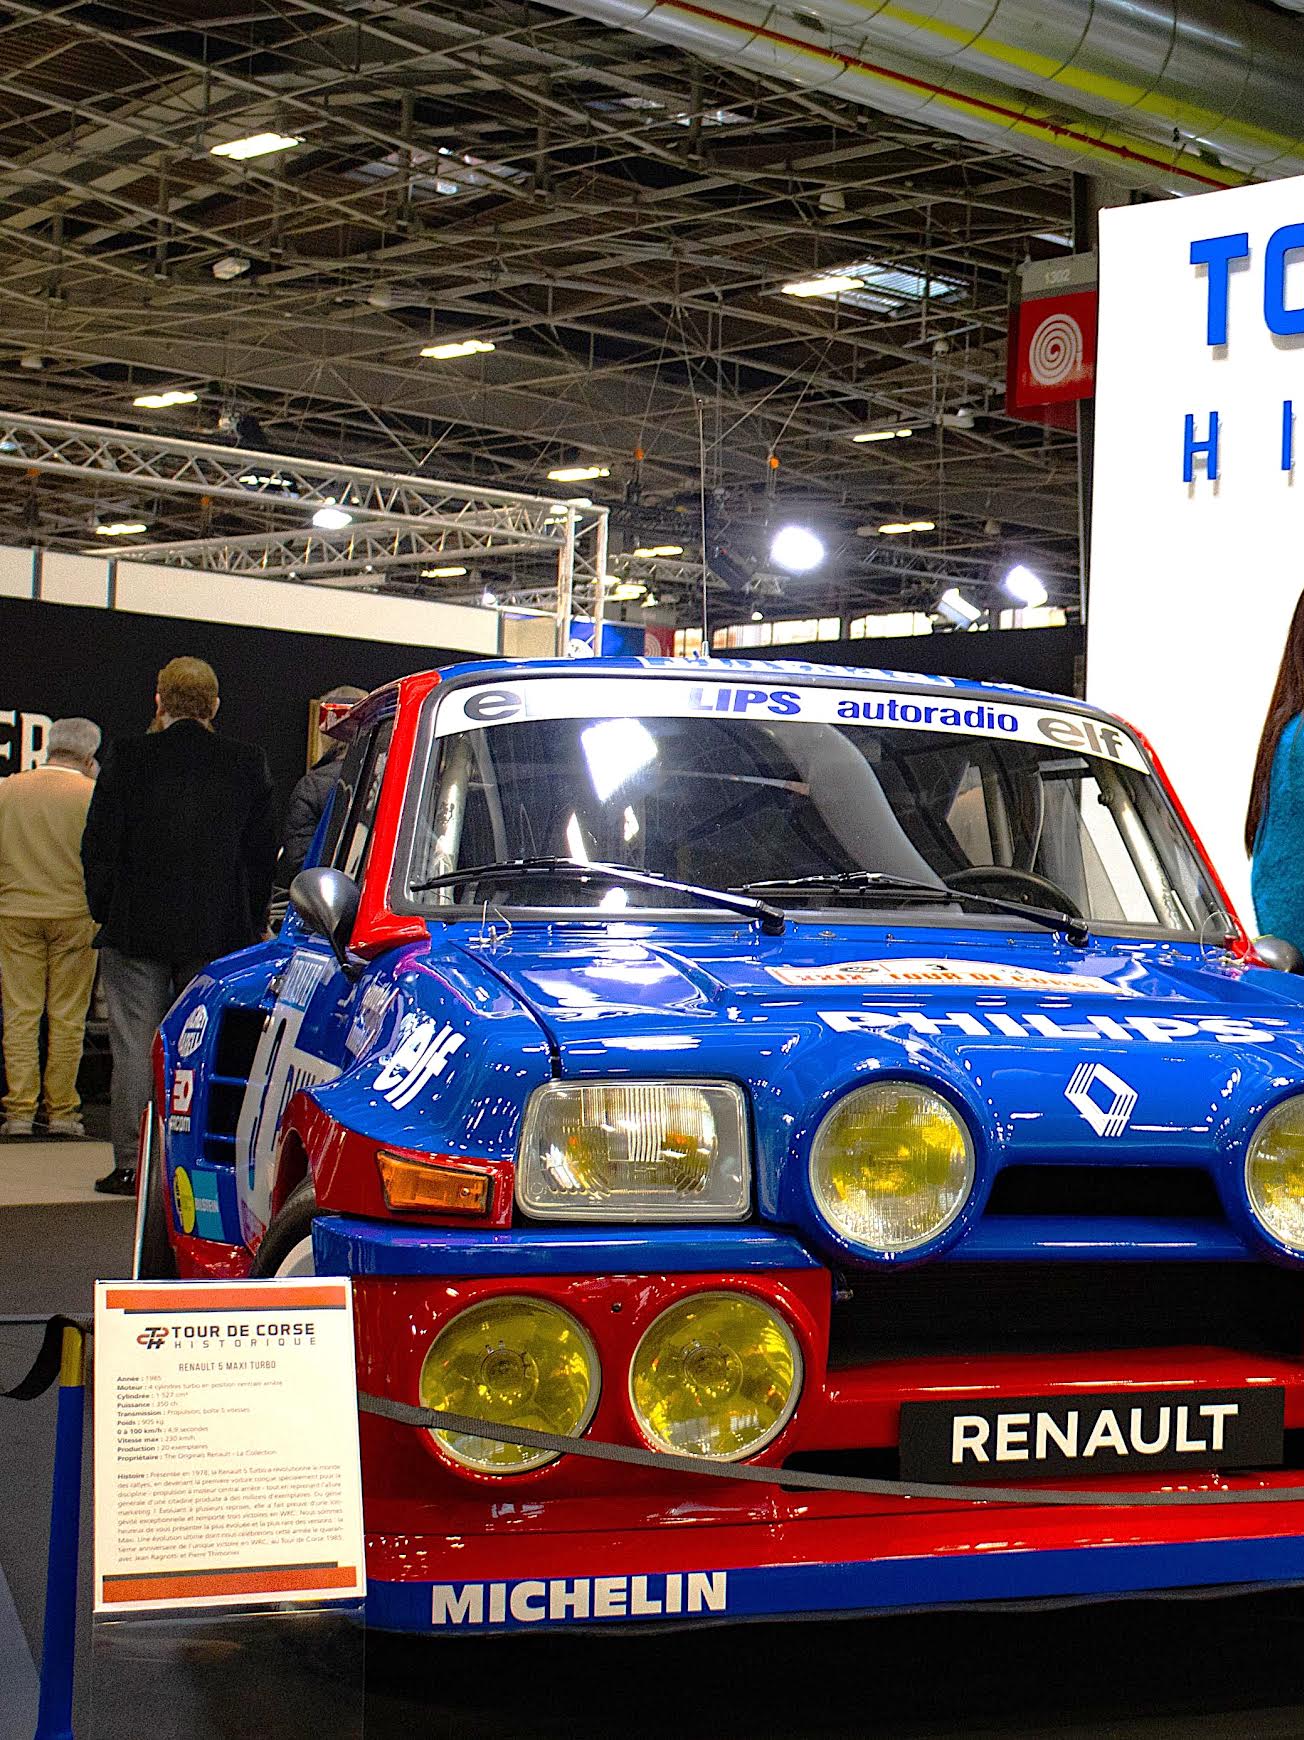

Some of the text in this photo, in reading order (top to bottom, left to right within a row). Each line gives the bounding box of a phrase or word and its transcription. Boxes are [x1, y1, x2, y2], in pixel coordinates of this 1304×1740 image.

[837, 700, 1019, 733] autoradio
[1037, 717, 1122, 759] elf
[817, 1011, 1276, 1045] PHILIPS
[373, 1018, 467, 1111] elf
[172, 1323, 315, 1338] TOUR DE CORSE
[175, 1337, 316, 1348] HISTORIQUE
[179, 1360, 276, 1372] RENAULT 5 MAXI TURBO
[952, 1403, 1239, 1463] RENAULT
[117, 1455, 159, 1463] Propriétaire
[432, 1571, 727, 1624] MICHELIN
